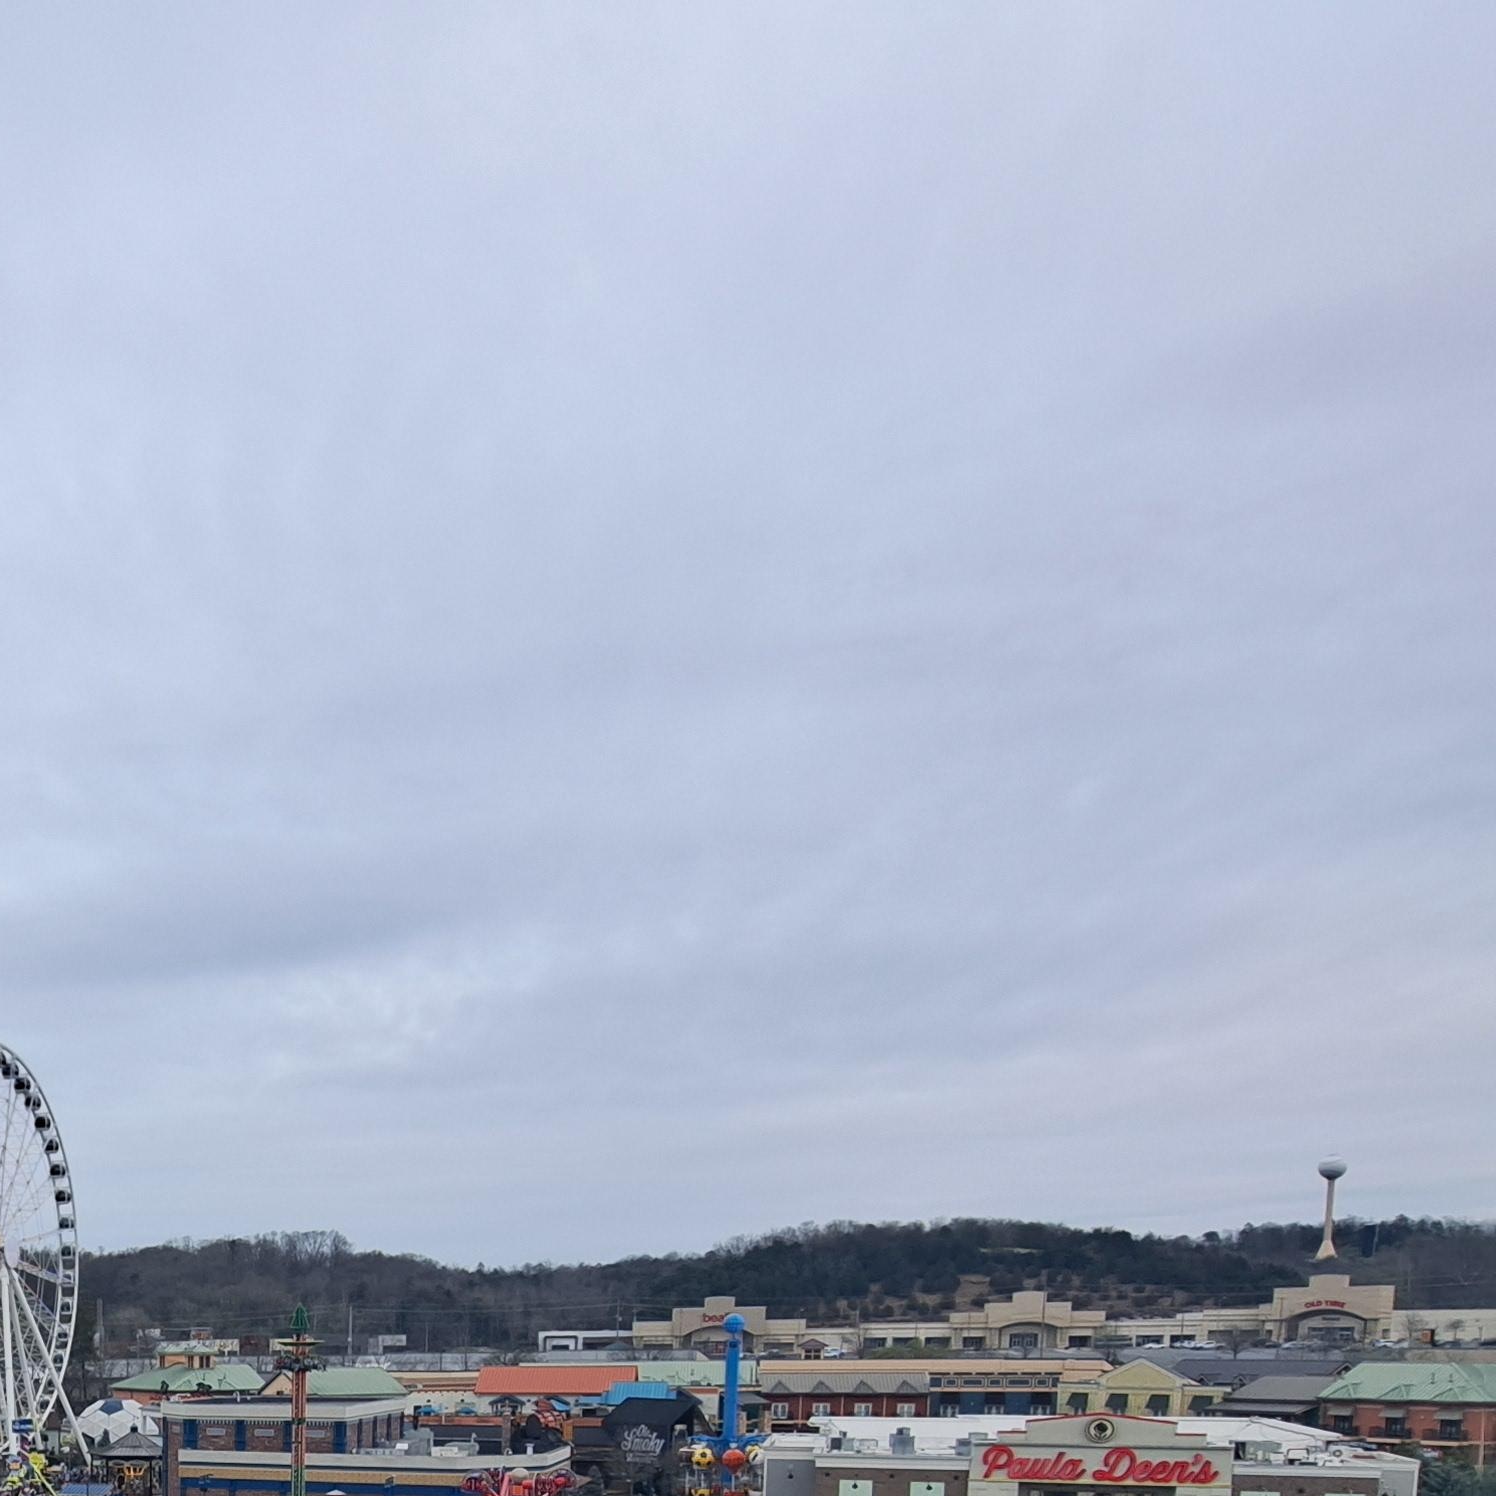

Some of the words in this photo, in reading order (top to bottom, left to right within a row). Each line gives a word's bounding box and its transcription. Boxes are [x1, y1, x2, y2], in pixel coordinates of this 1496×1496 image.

[703, 1312, 727, 1323] bea
[620, 1428, 665, 1456] Smoky
[982, 1444, 1087, 1481] Paula
[1092, 1446, 1219, 1484] Deen's
